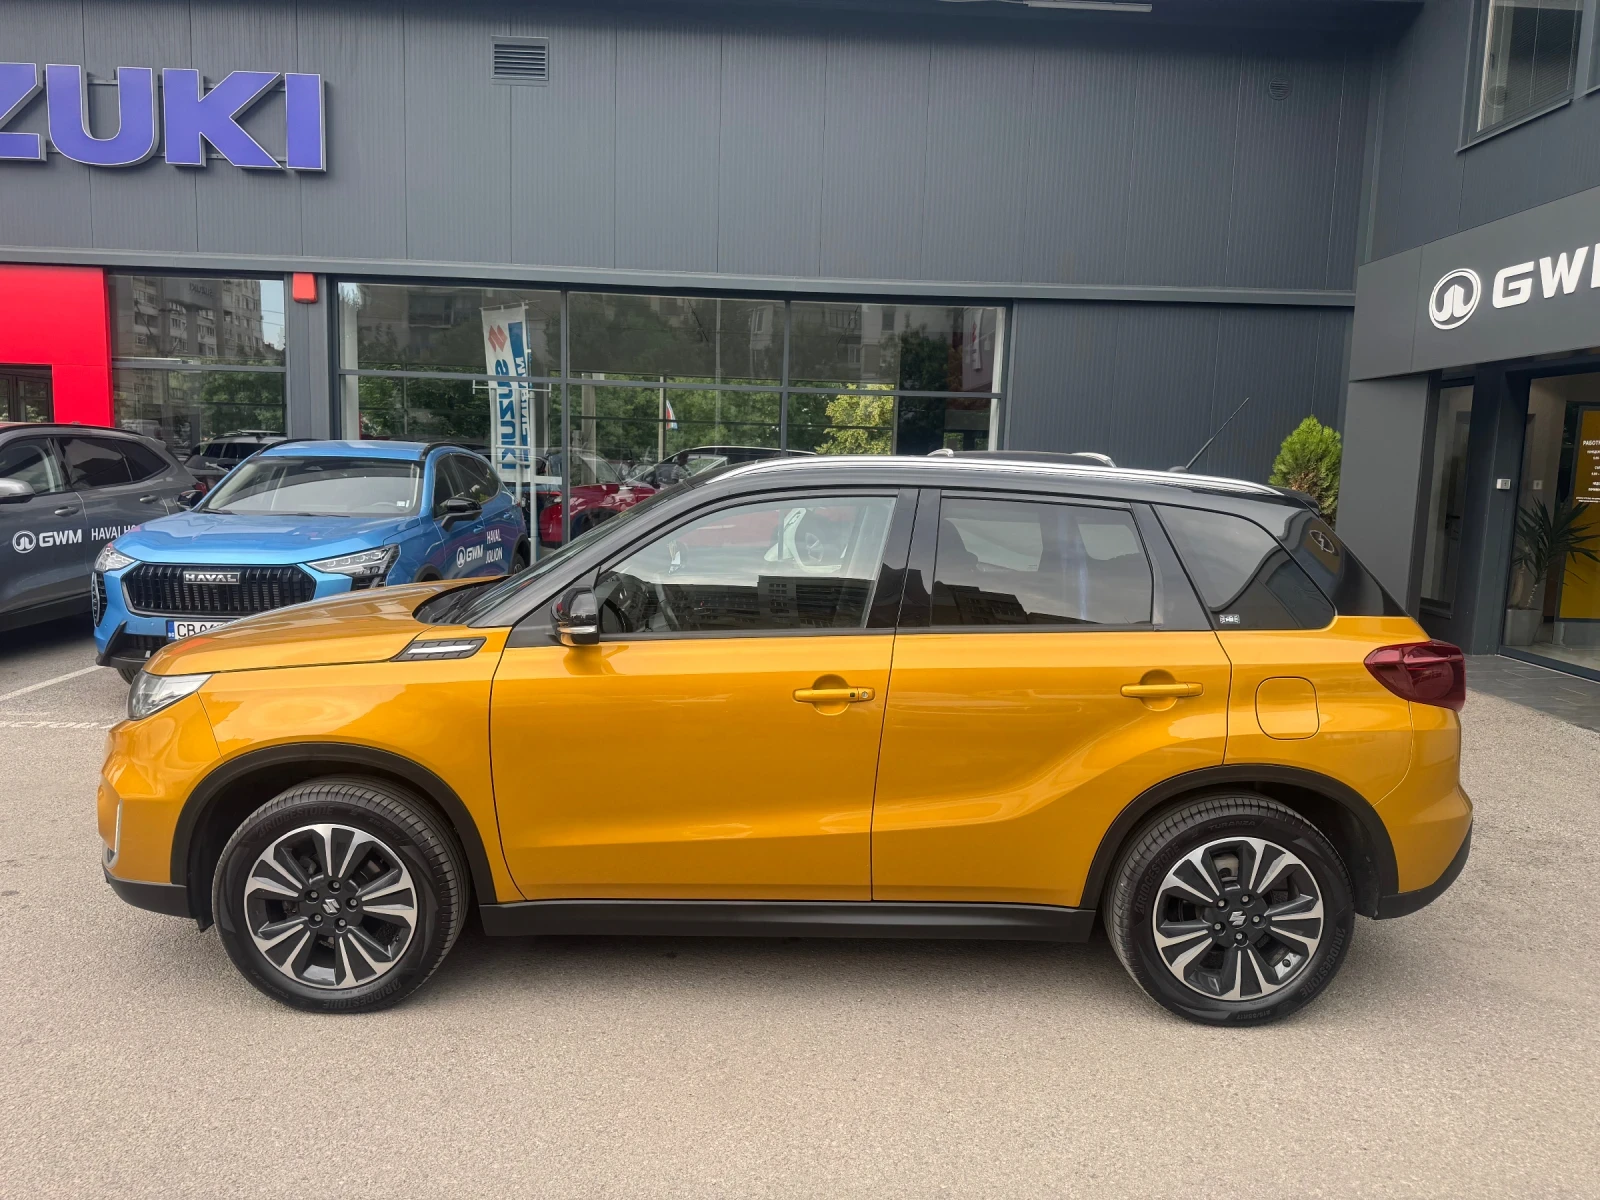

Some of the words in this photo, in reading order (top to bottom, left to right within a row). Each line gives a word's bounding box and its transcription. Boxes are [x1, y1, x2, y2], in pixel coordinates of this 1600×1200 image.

[39, 529, 82, 547] GWM
[486, 529, 502, 545] HAVAL
[466, 544, 484, 562] GWM
[185, 573, 237, 582] HAVAL
[256, 805, 334, 838] BRIDGESTONE
[1207, 819, 1256, 831] TURANZA
[1134, 841, 1181, 915] BRIDGESTONE
[1299, 927, 1347, 998] BRIDGESTONE
[322, 977, 402, 1010] BRIDGESTONE
